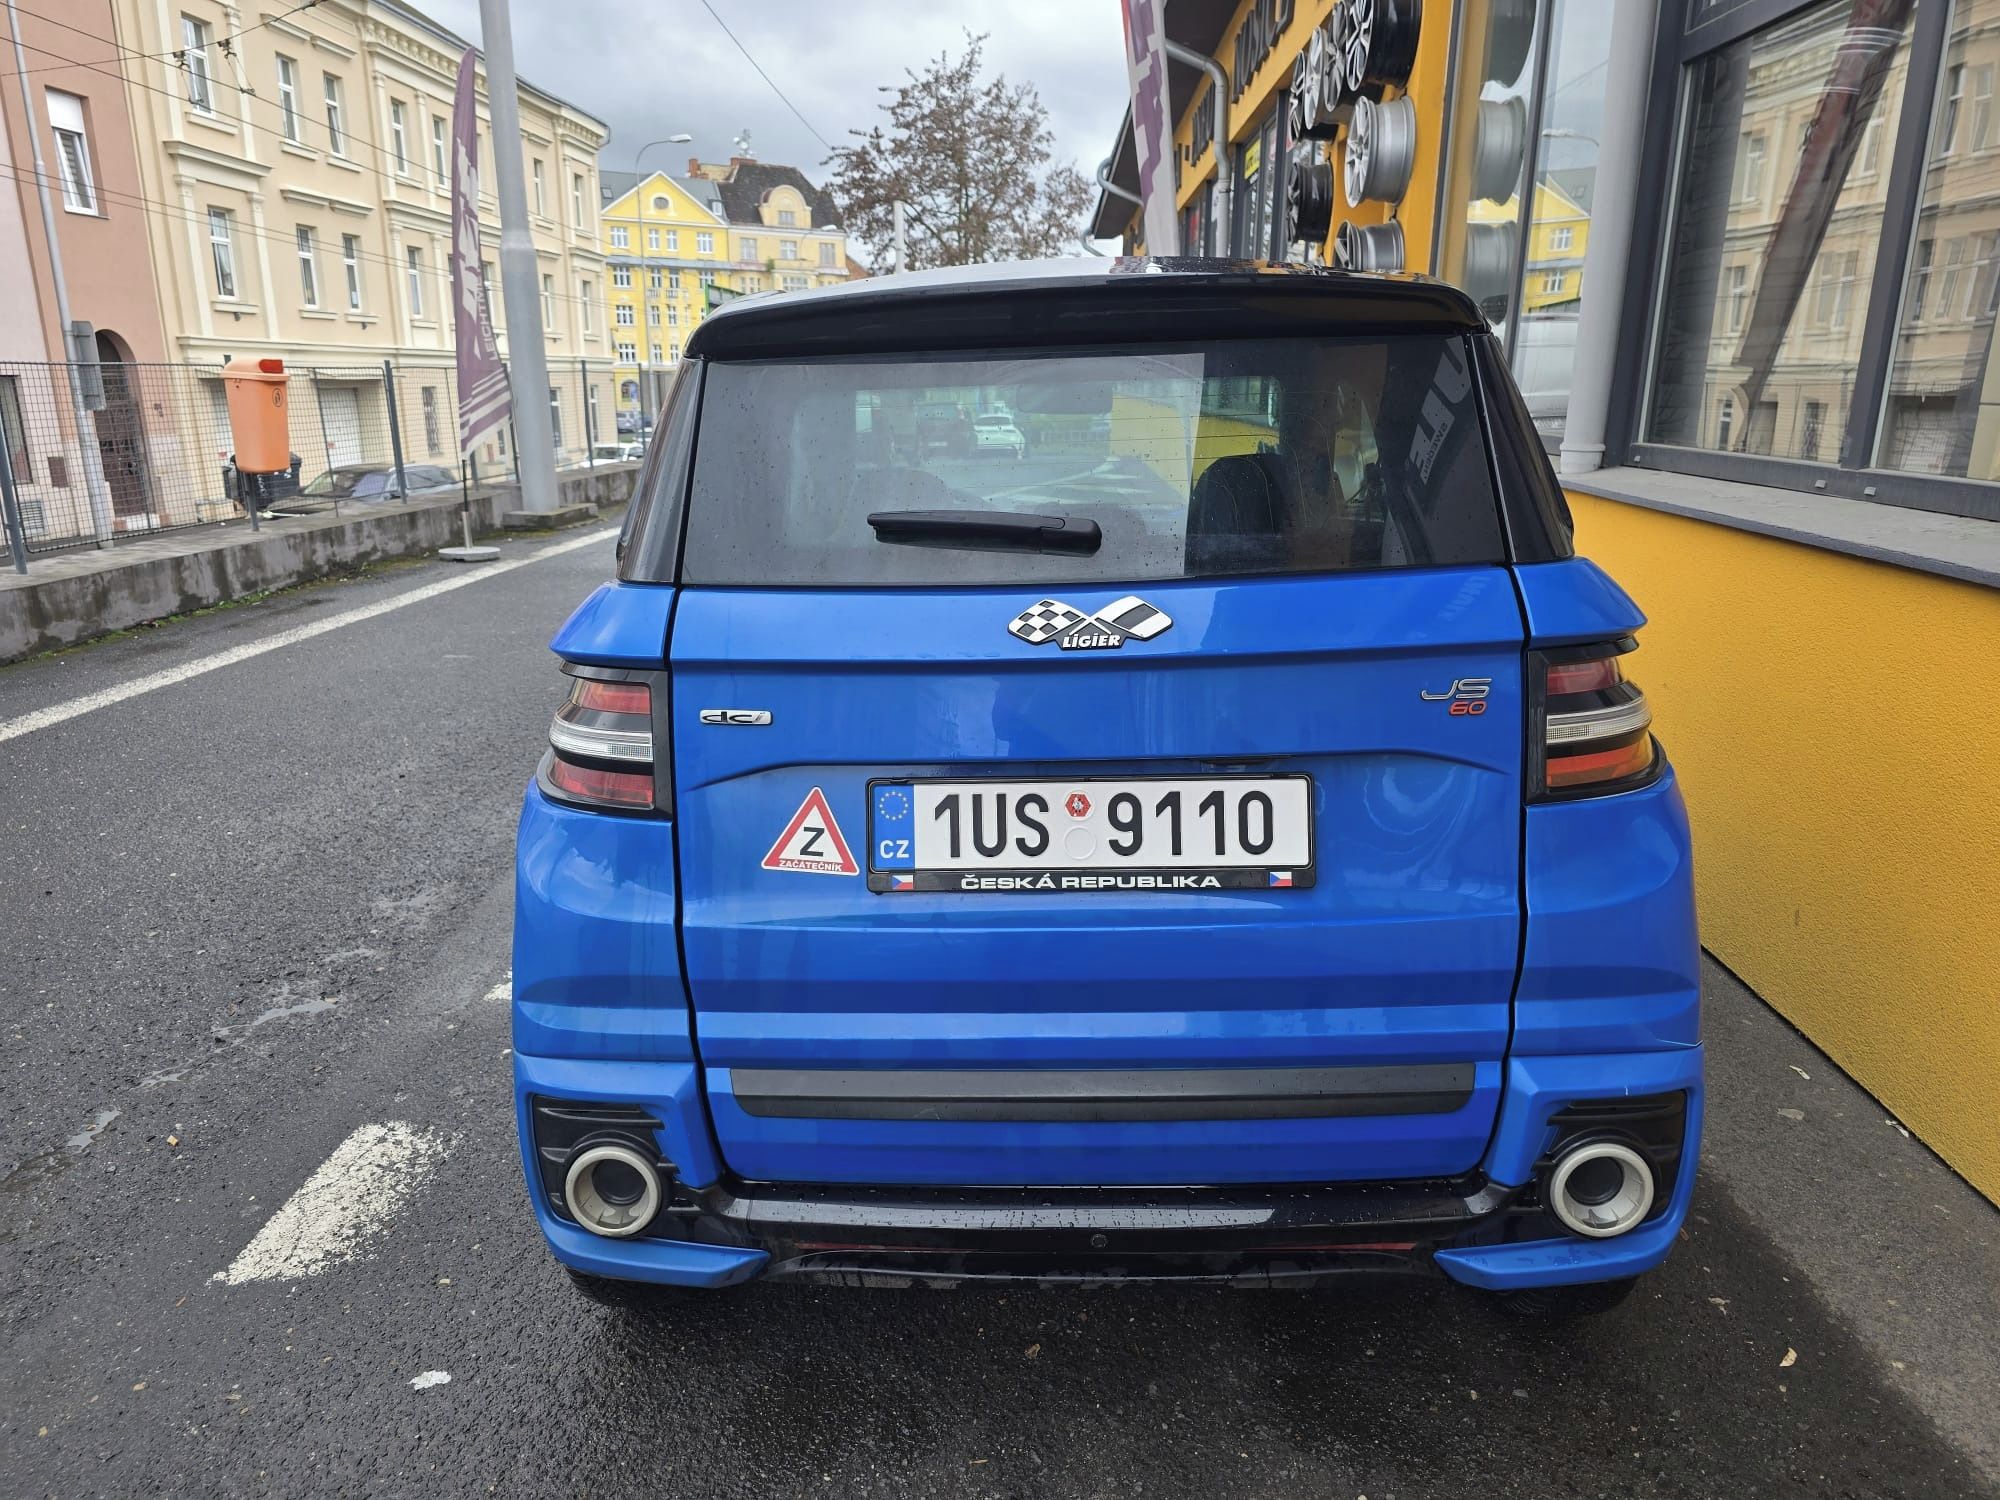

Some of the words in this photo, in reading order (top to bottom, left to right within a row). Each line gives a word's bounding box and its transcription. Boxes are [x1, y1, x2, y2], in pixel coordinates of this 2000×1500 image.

[1421, 678, 1492, 700] JS
[1449, 701, 1487, 715] 60
[935, 793, 1050, 858] 1US
[1107, 790, 1274, 857] 9110
[800, 826, 825, 857] Z
[880, 839, 909, 859] CZ
[961, 873, 1056, 889] ČESKÁ
[1061, 875, 1222, 889] REPUBLIKA
